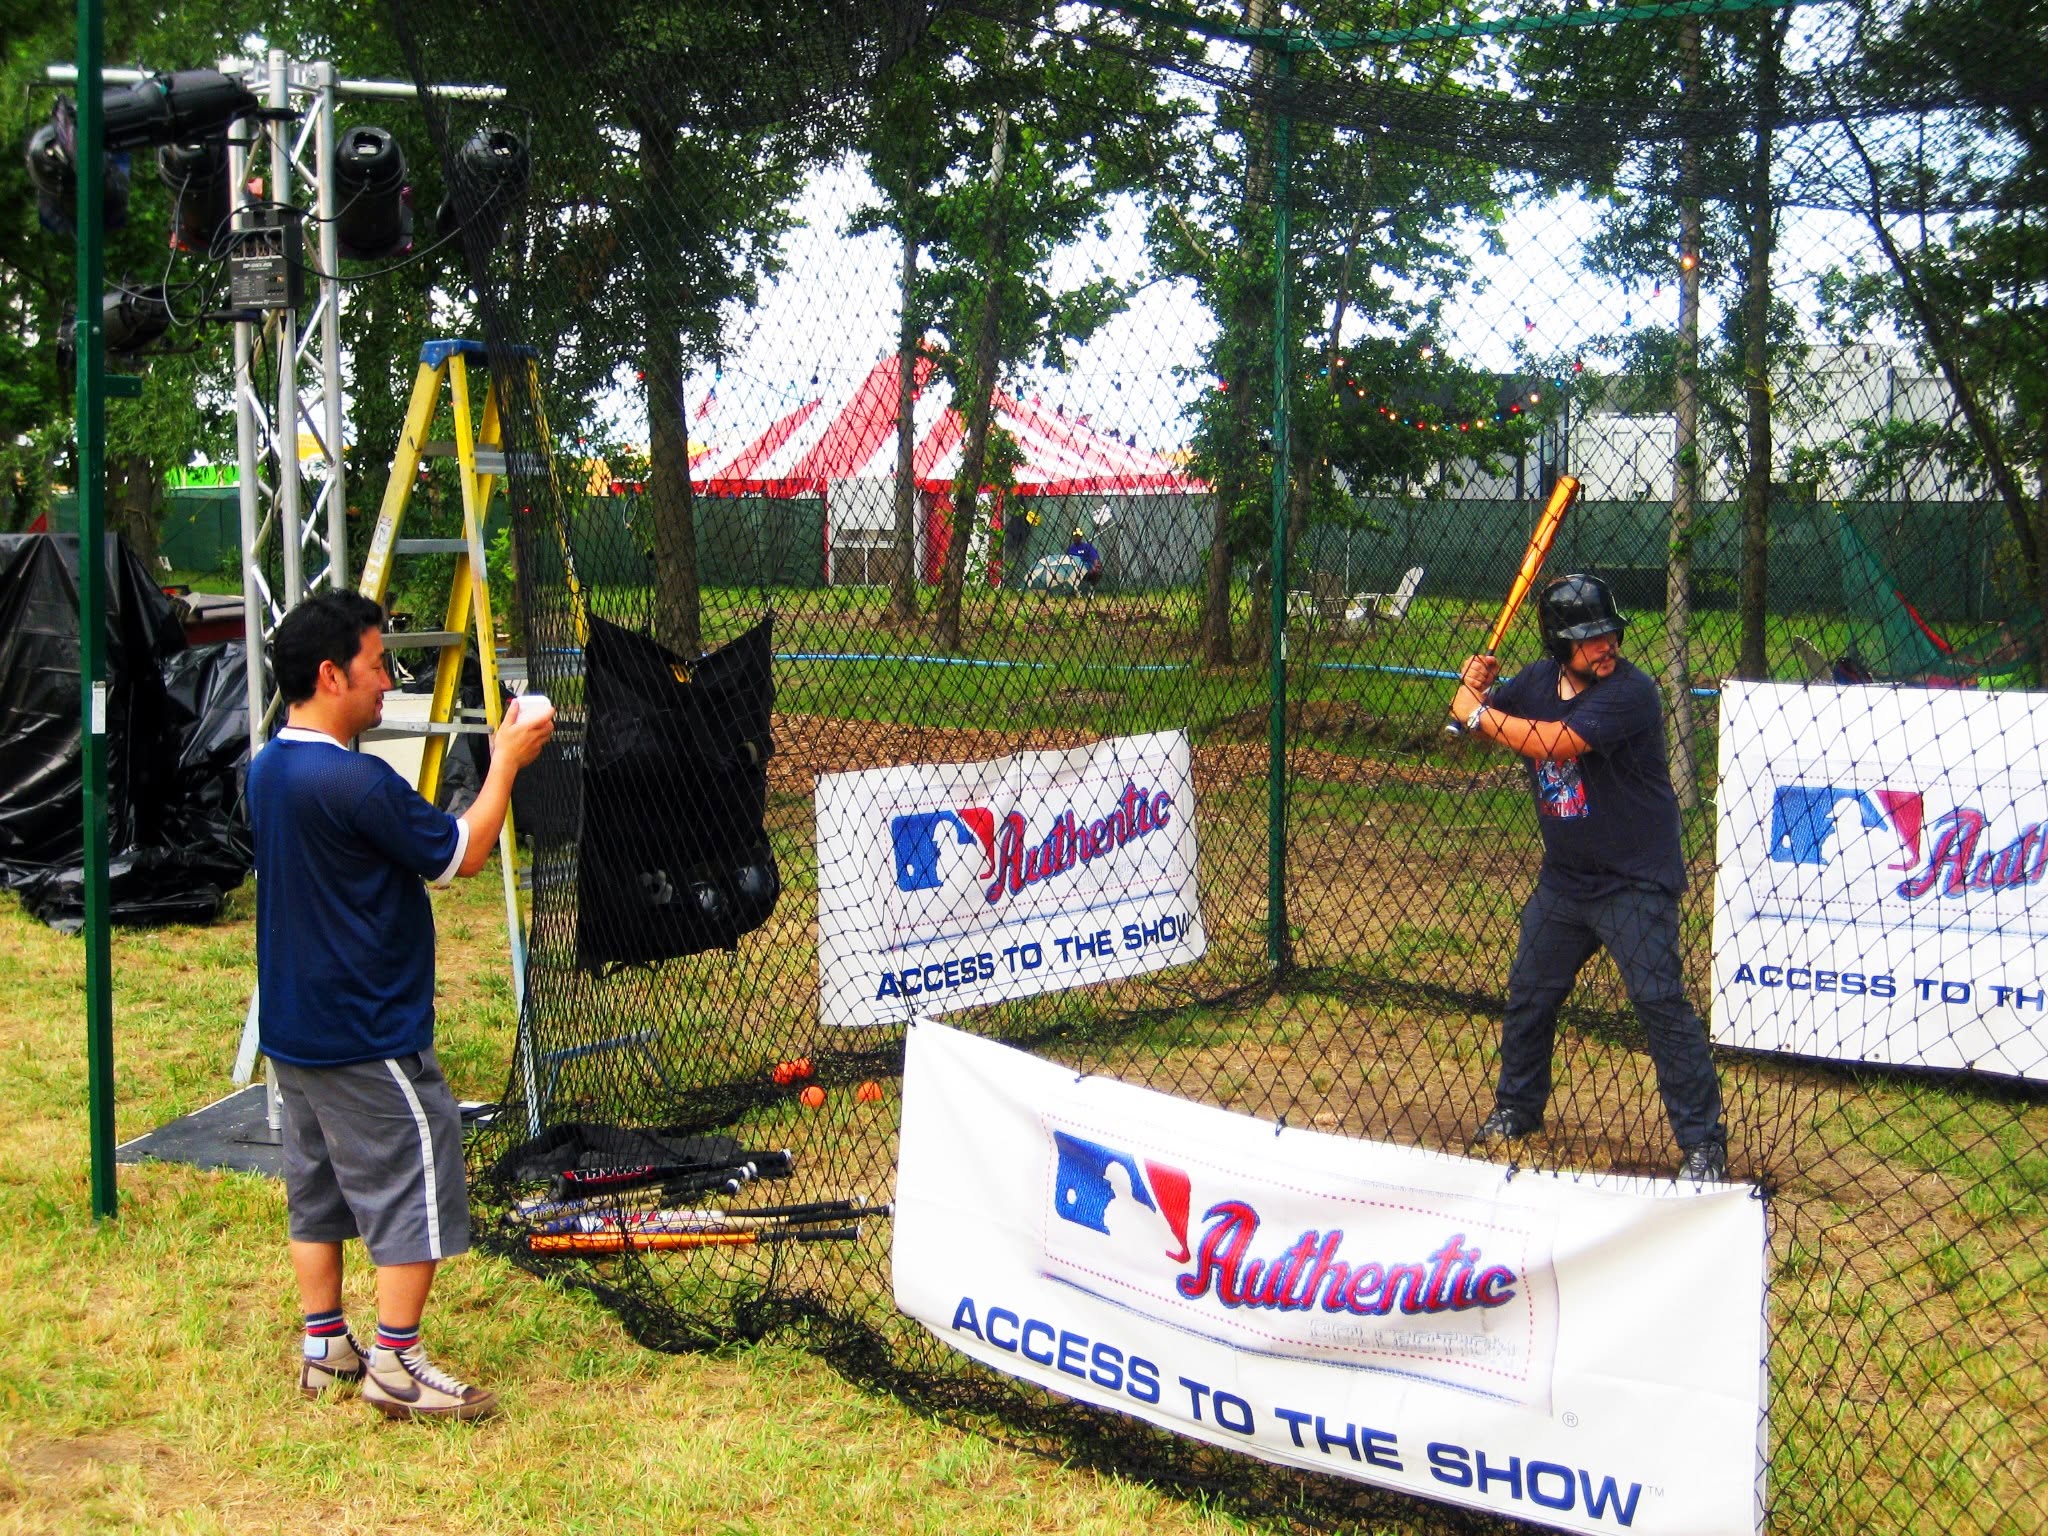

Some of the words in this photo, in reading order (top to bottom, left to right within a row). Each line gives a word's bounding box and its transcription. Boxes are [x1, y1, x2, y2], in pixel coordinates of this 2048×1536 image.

[986, 782, 1172, 906] Authentic
[875, 952, 995, 1001] ACCESS
[1004, 942, 1042, 973] TO
[1053, 930, 1114, 963] THE
[1123, 911, 1191, 950] SHOW
[1734, 963, 1897, 998] ACCESS
[1913, 978, 1972, 1005] TO
[1175, 1199, 1517, 1317] Authentic
[952, 1296, 1160, 1404] ACCESS
[1179, 1375, 1256, 1436] TO
[1274, 1406, 1404, 1472] THE
[1427, 1441, 1642, 1527] SHOW
